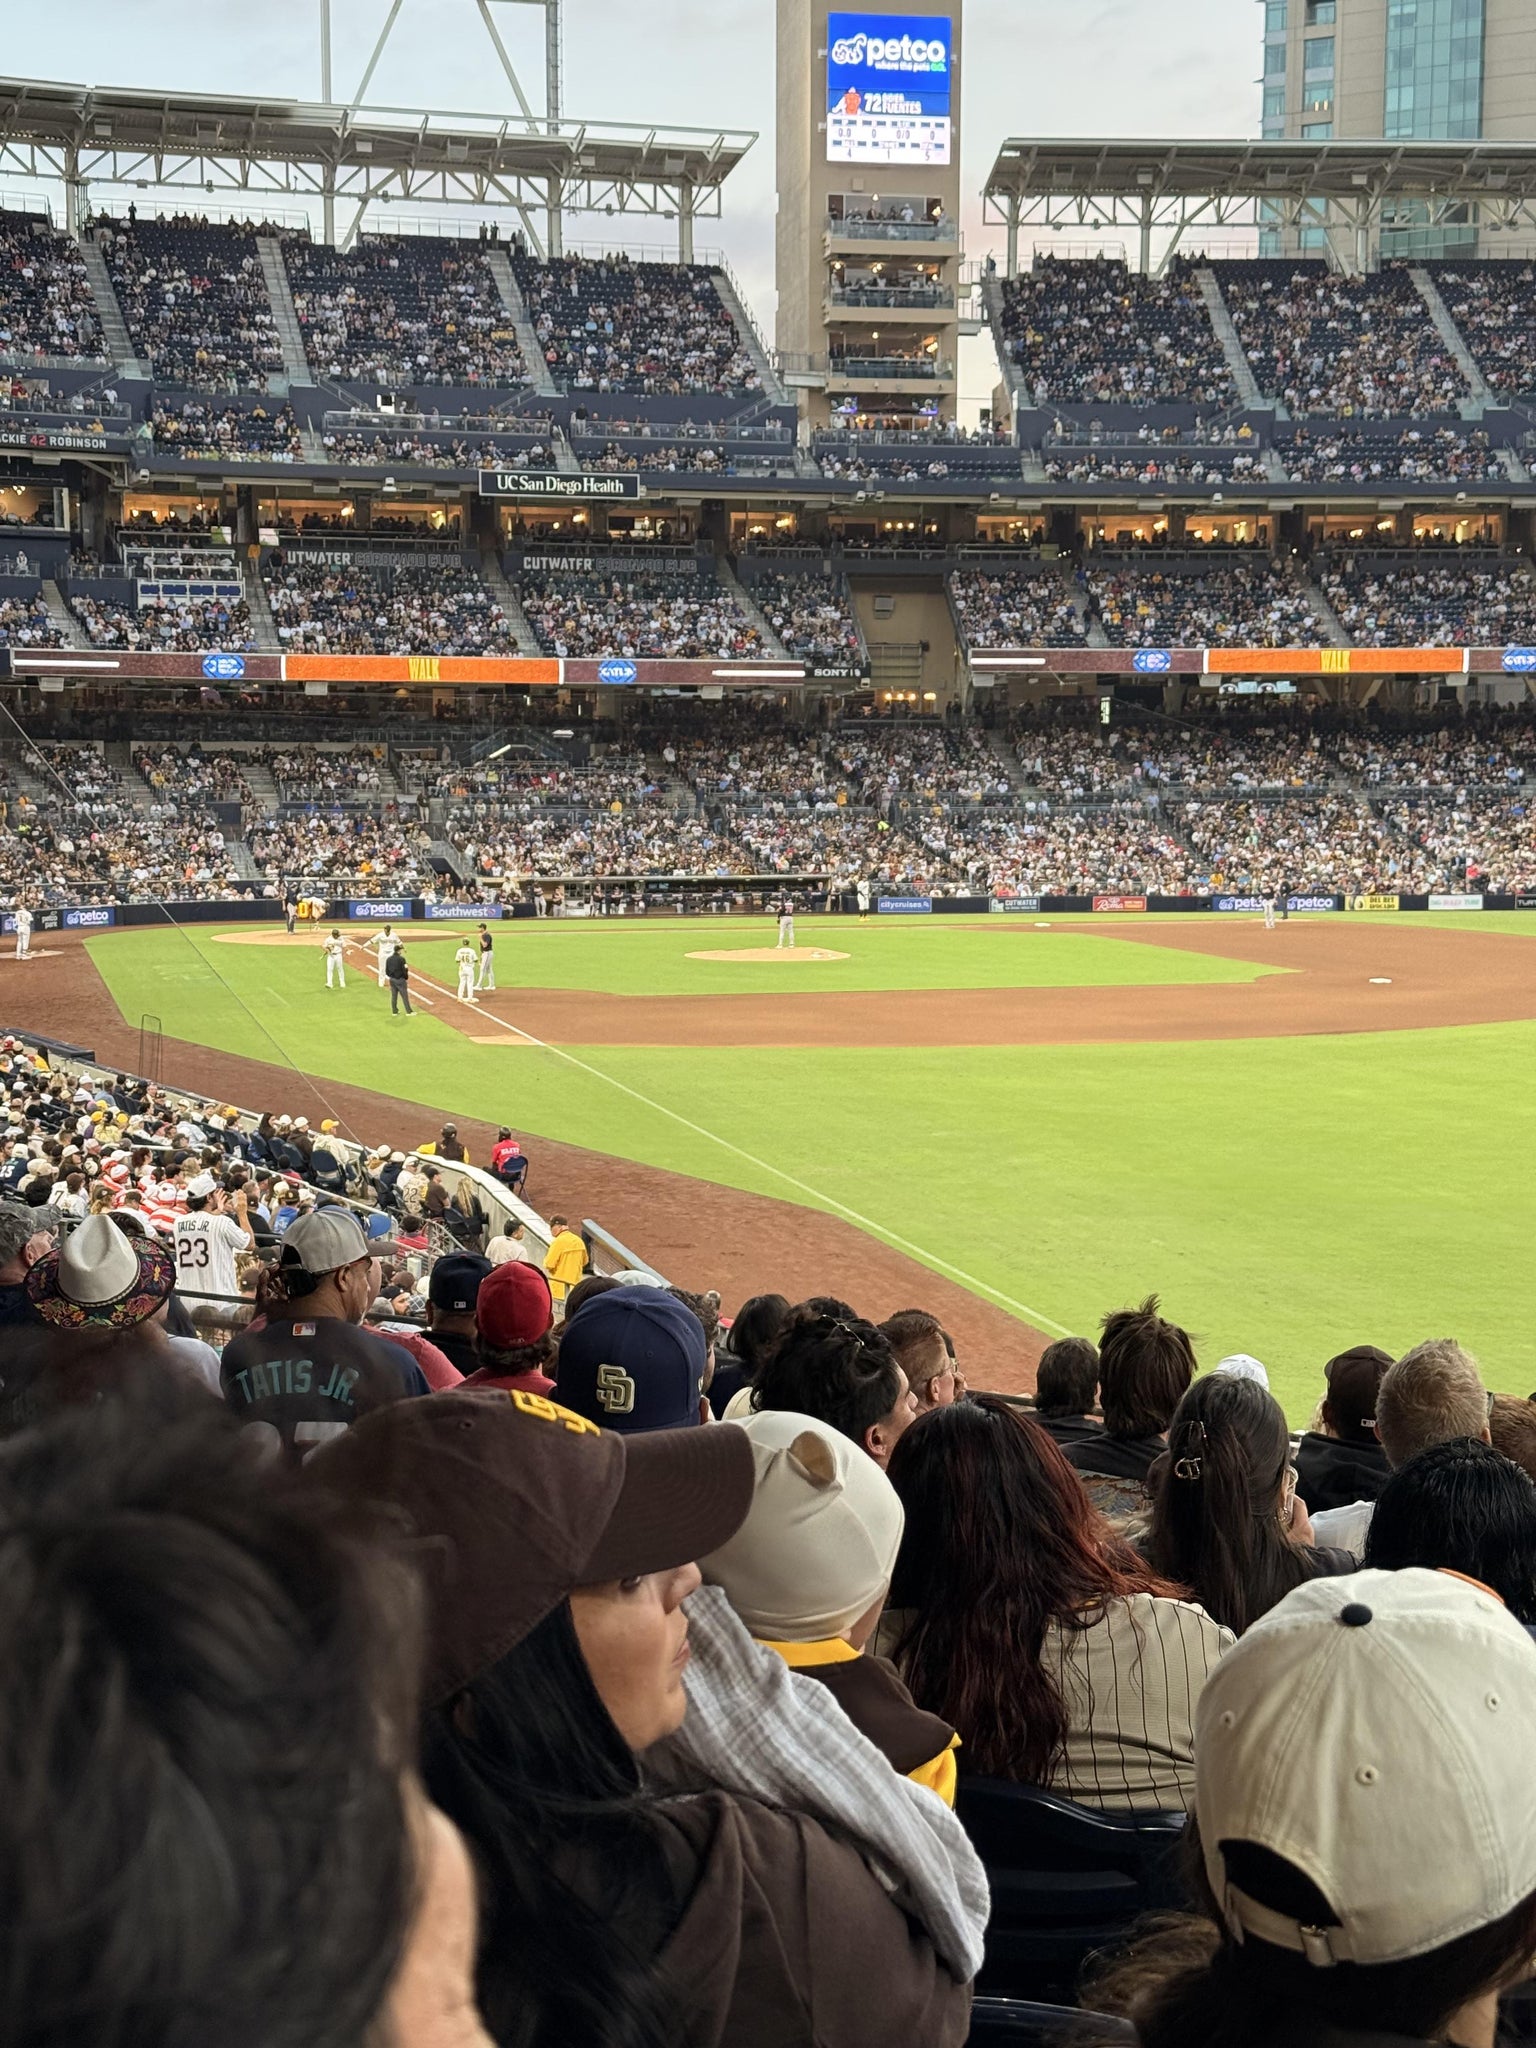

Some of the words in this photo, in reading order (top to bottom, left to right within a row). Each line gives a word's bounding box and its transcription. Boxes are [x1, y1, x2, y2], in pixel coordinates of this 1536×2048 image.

[866, 33, 946, 67] petco
[864, 92, 882, 113] 72
[0, 433, 27, 444] CKIE
[30, 435, 46, 446] 42
[49, 436, 107, 449] ROBINSON
[496, 475, 517, 491] UC
[519, 475, 544, 491] San
[545, 476, 581, 495] Diego
[583, 477, 623, 493] Health
[286, 551, 352, 565] UTWATER
[408, 657, 440, 681] WALK
[814, 668, 848, 677] SONY
[371, 902, 404, 914] petco
[431, 905, 489, 917] Southwest
[1298, 897, 1333, 910] petco
[80, 910, 109, 923] petco
[178, 1220, 197, 1233] TATIS
[197, 1220, 210, 1233] JR.
[178, 1238, 210, 1268] 23
[236, 1359, 314, 1404] TATIS
[318, 1363, 359, 1406] JR.
[596, 1363, 636, 1414] SD
